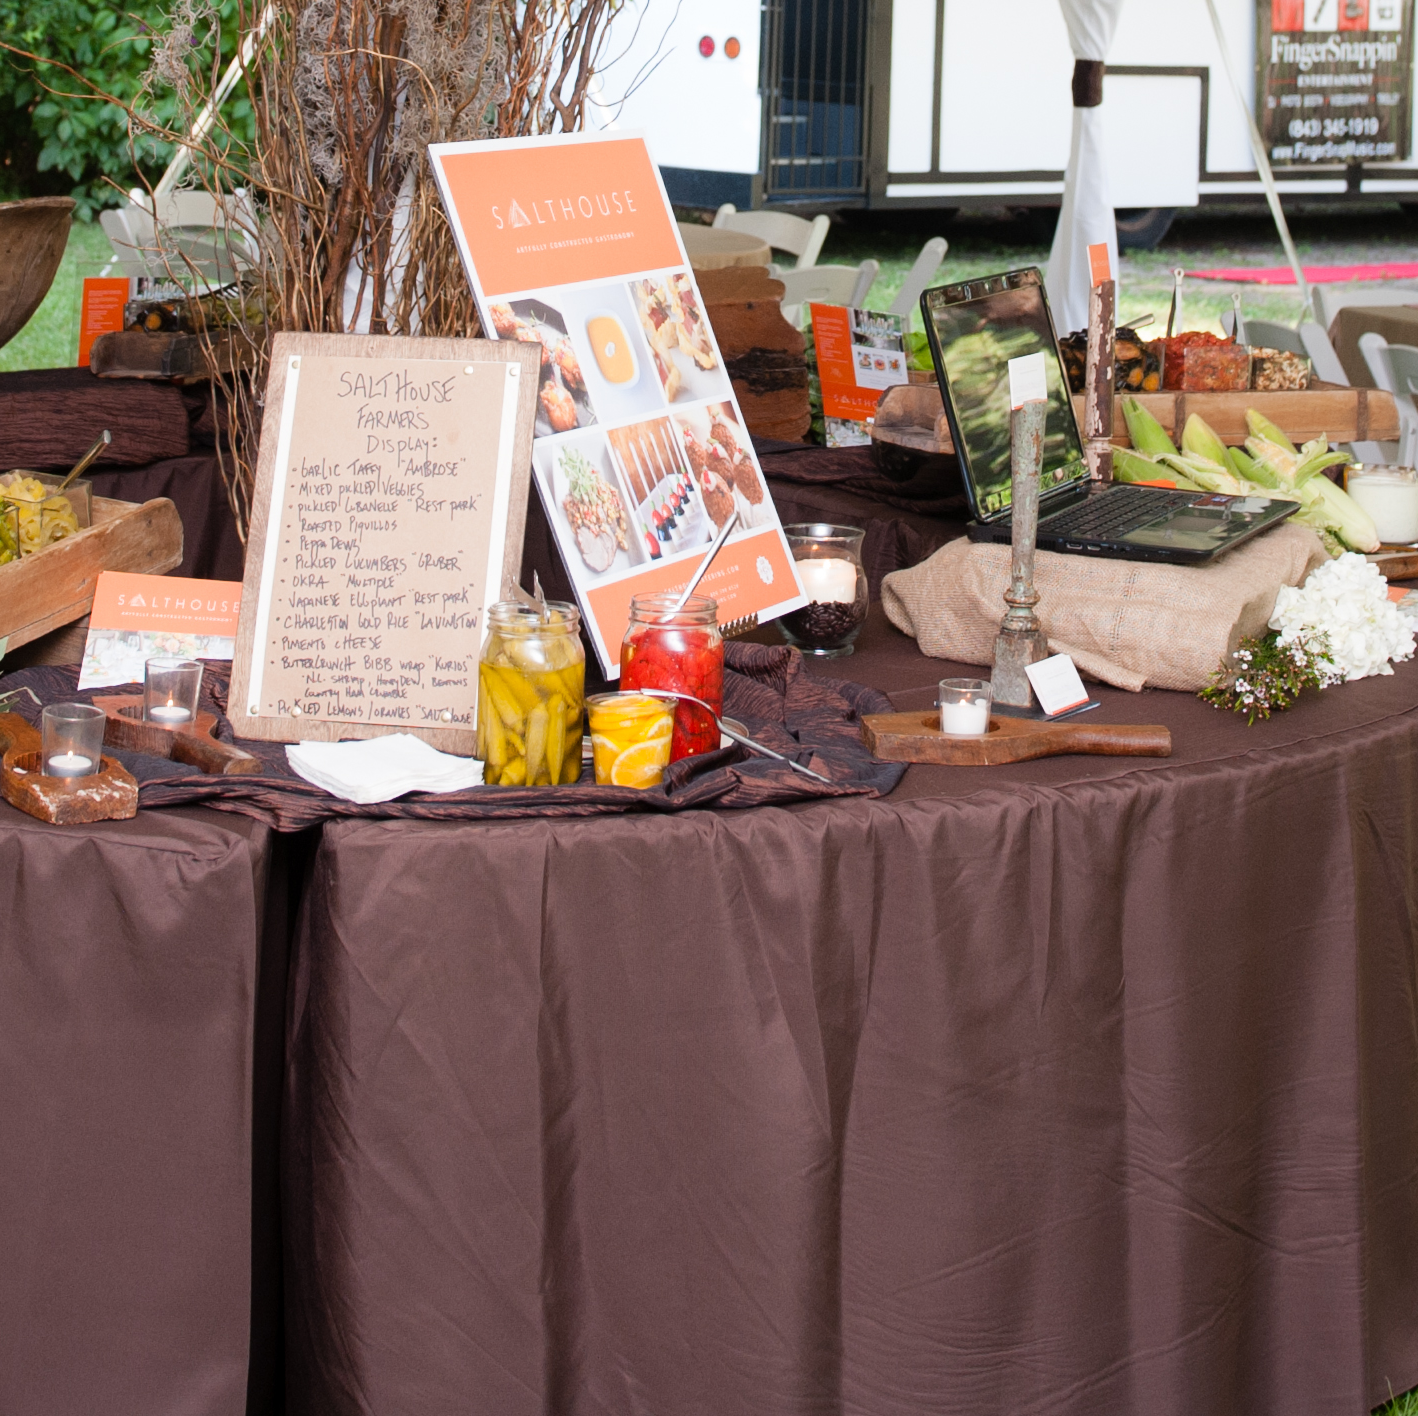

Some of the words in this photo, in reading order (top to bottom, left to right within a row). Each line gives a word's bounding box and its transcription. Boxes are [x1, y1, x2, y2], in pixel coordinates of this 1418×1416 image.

[491, 190, 637, 229] SALTHOUSE
[516, 244, 547, 254] ARTFULLY
[550, 237, 593, 249] CONSTRUCTED
[595, 231, 635, 243] GASTRONOMY
[833, 394, 878, 407] SALTHO
[292, 574, 330, 589] OKRA
[117, 593, 240, 613] SALTHOUSE
[387, 612, 409, 629] RICE
[281, 636, 326, 650] PIMENTO
[364, 655, 393, 672] BIBB
